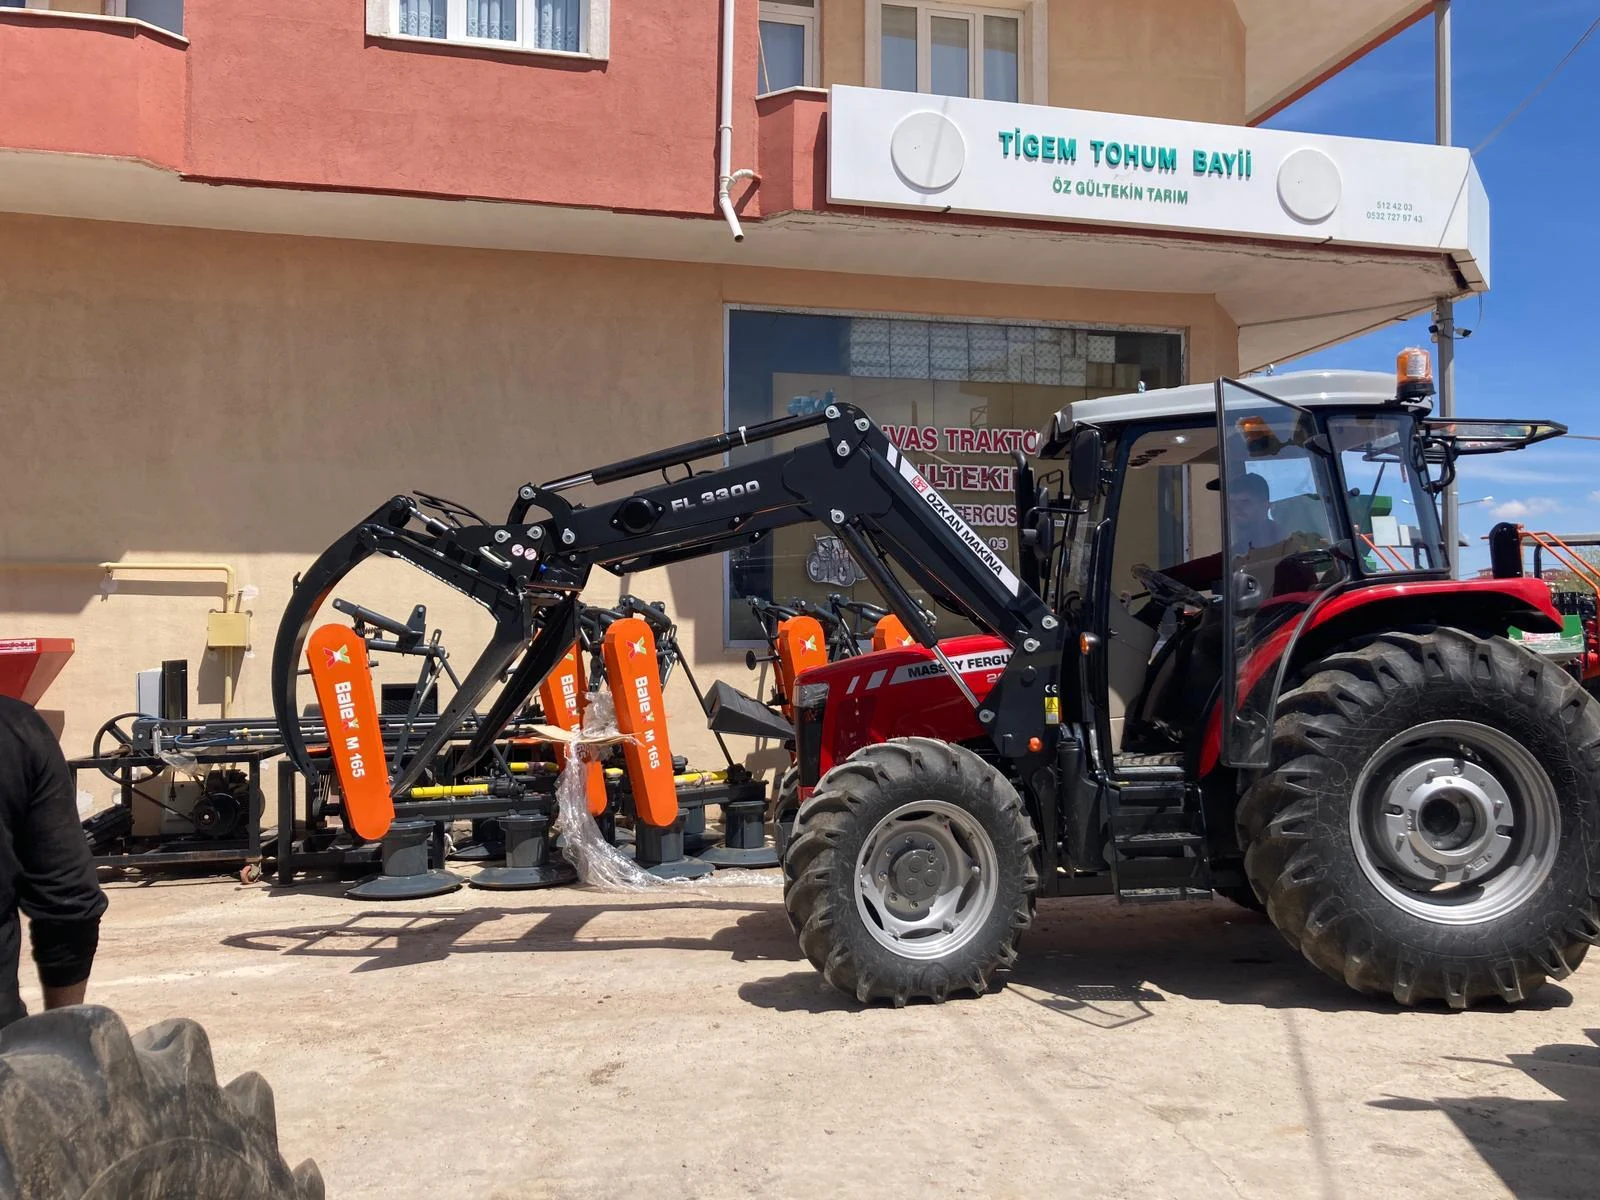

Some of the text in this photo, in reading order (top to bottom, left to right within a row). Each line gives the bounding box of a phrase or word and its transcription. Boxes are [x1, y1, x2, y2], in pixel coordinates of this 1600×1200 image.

[998, 127, 1077, 163] TİGEM
[1089, 139, 1177, 173] TOHUM
[1052, 176, 1188, 205] ÖZ GÜLTEKİN TARIM
[1366, 211, 1385, 220] 0532
[1387, 212, 1401, 221] 727
[1413, 215, 1423, 223] 43
[1376, 201, 1413, 211] 512 42 03
[882, 425, 938, 451] VAS
[671, 480, 760, 512] FL 3300
[926, 492, 1003, 576] ÖZKAN MAKİNA
[907, 659, 964, 678] MASSY
[345, 736, 360, 750] M
[643, 729, 655, 742] M
[349, 753, 366, 778] 165
[647, 745, 660, 769] 165
